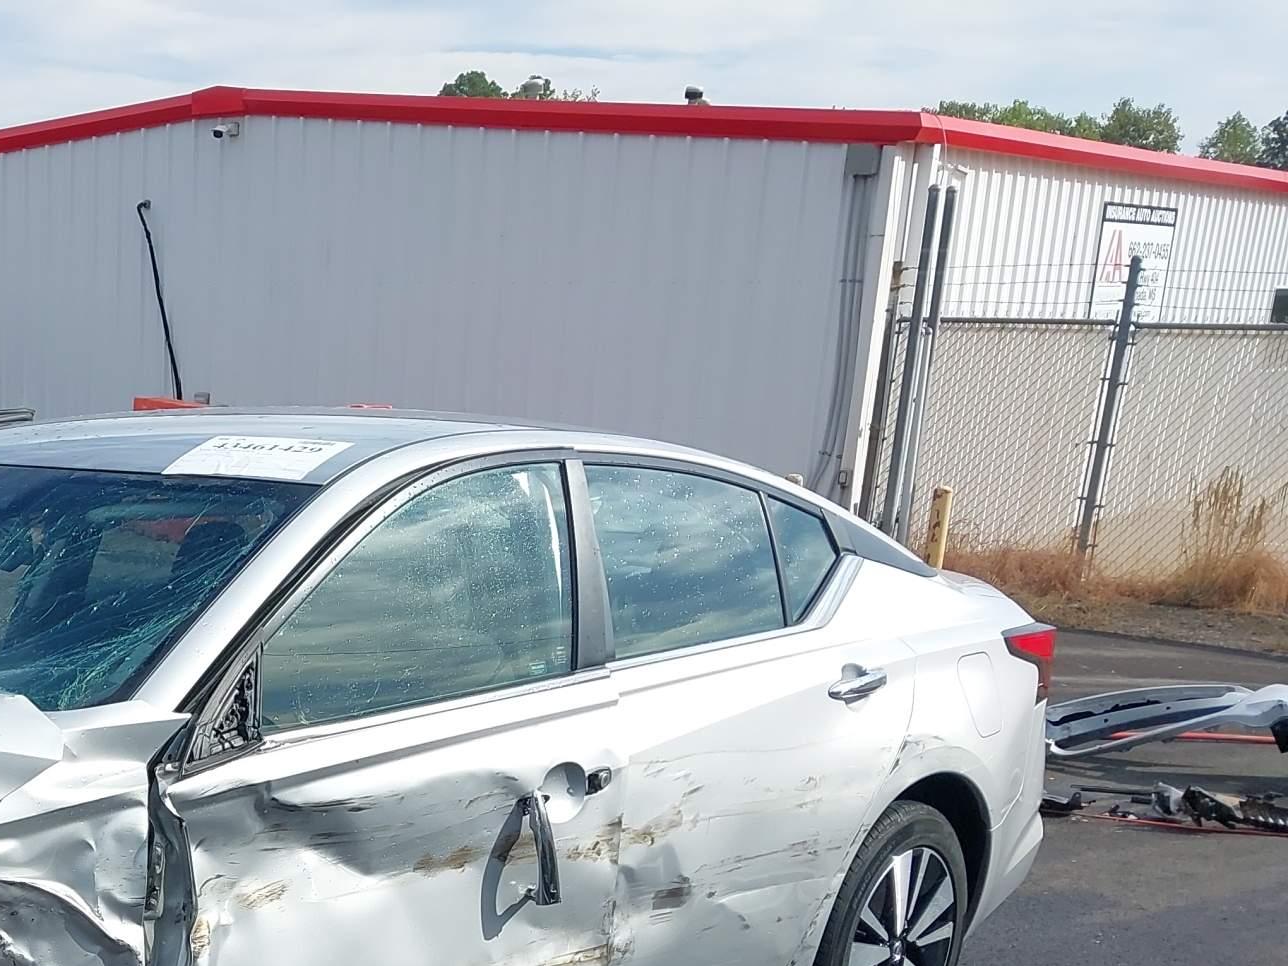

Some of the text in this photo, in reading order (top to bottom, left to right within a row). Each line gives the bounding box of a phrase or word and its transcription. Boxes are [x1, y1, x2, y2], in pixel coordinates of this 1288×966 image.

[1105, 205, 1176, 225] INSURANCE AUTO AUCTIONS
